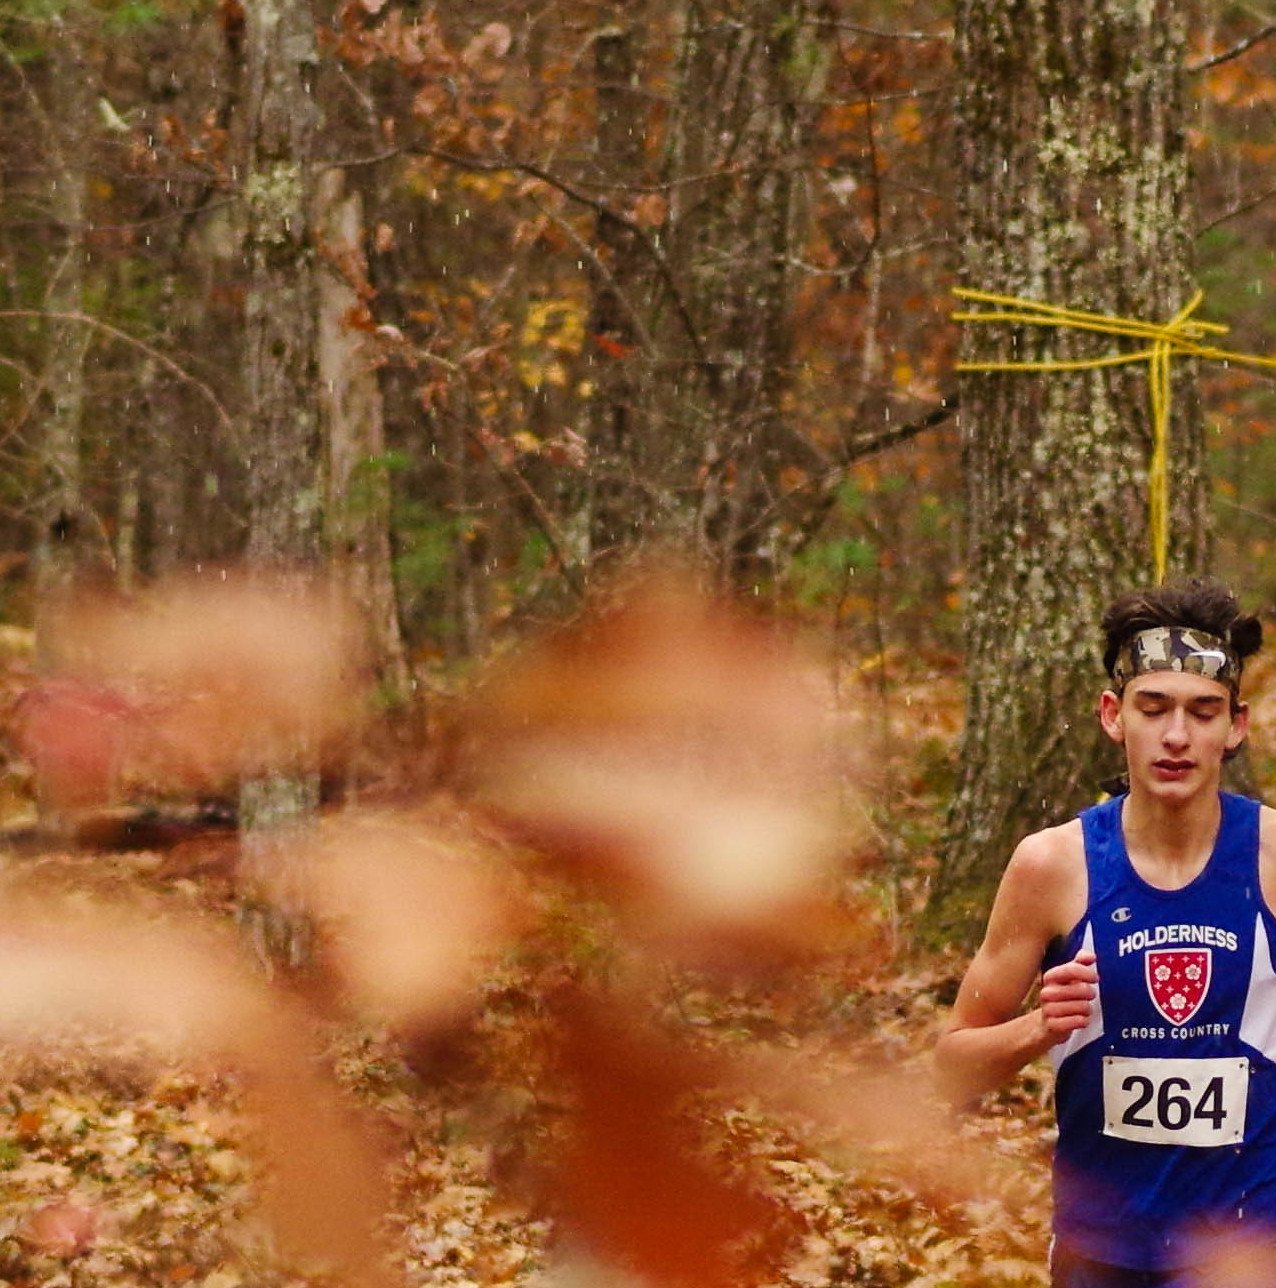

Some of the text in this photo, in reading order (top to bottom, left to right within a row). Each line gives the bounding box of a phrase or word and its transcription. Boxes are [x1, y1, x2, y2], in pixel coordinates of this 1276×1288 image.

[1118, 925, 1238, 957] HOLDERNESS
[1121, 1023, 1230, 1039] CROSS COUNTRY
[1121, 1075, 1227, 1131] 264
